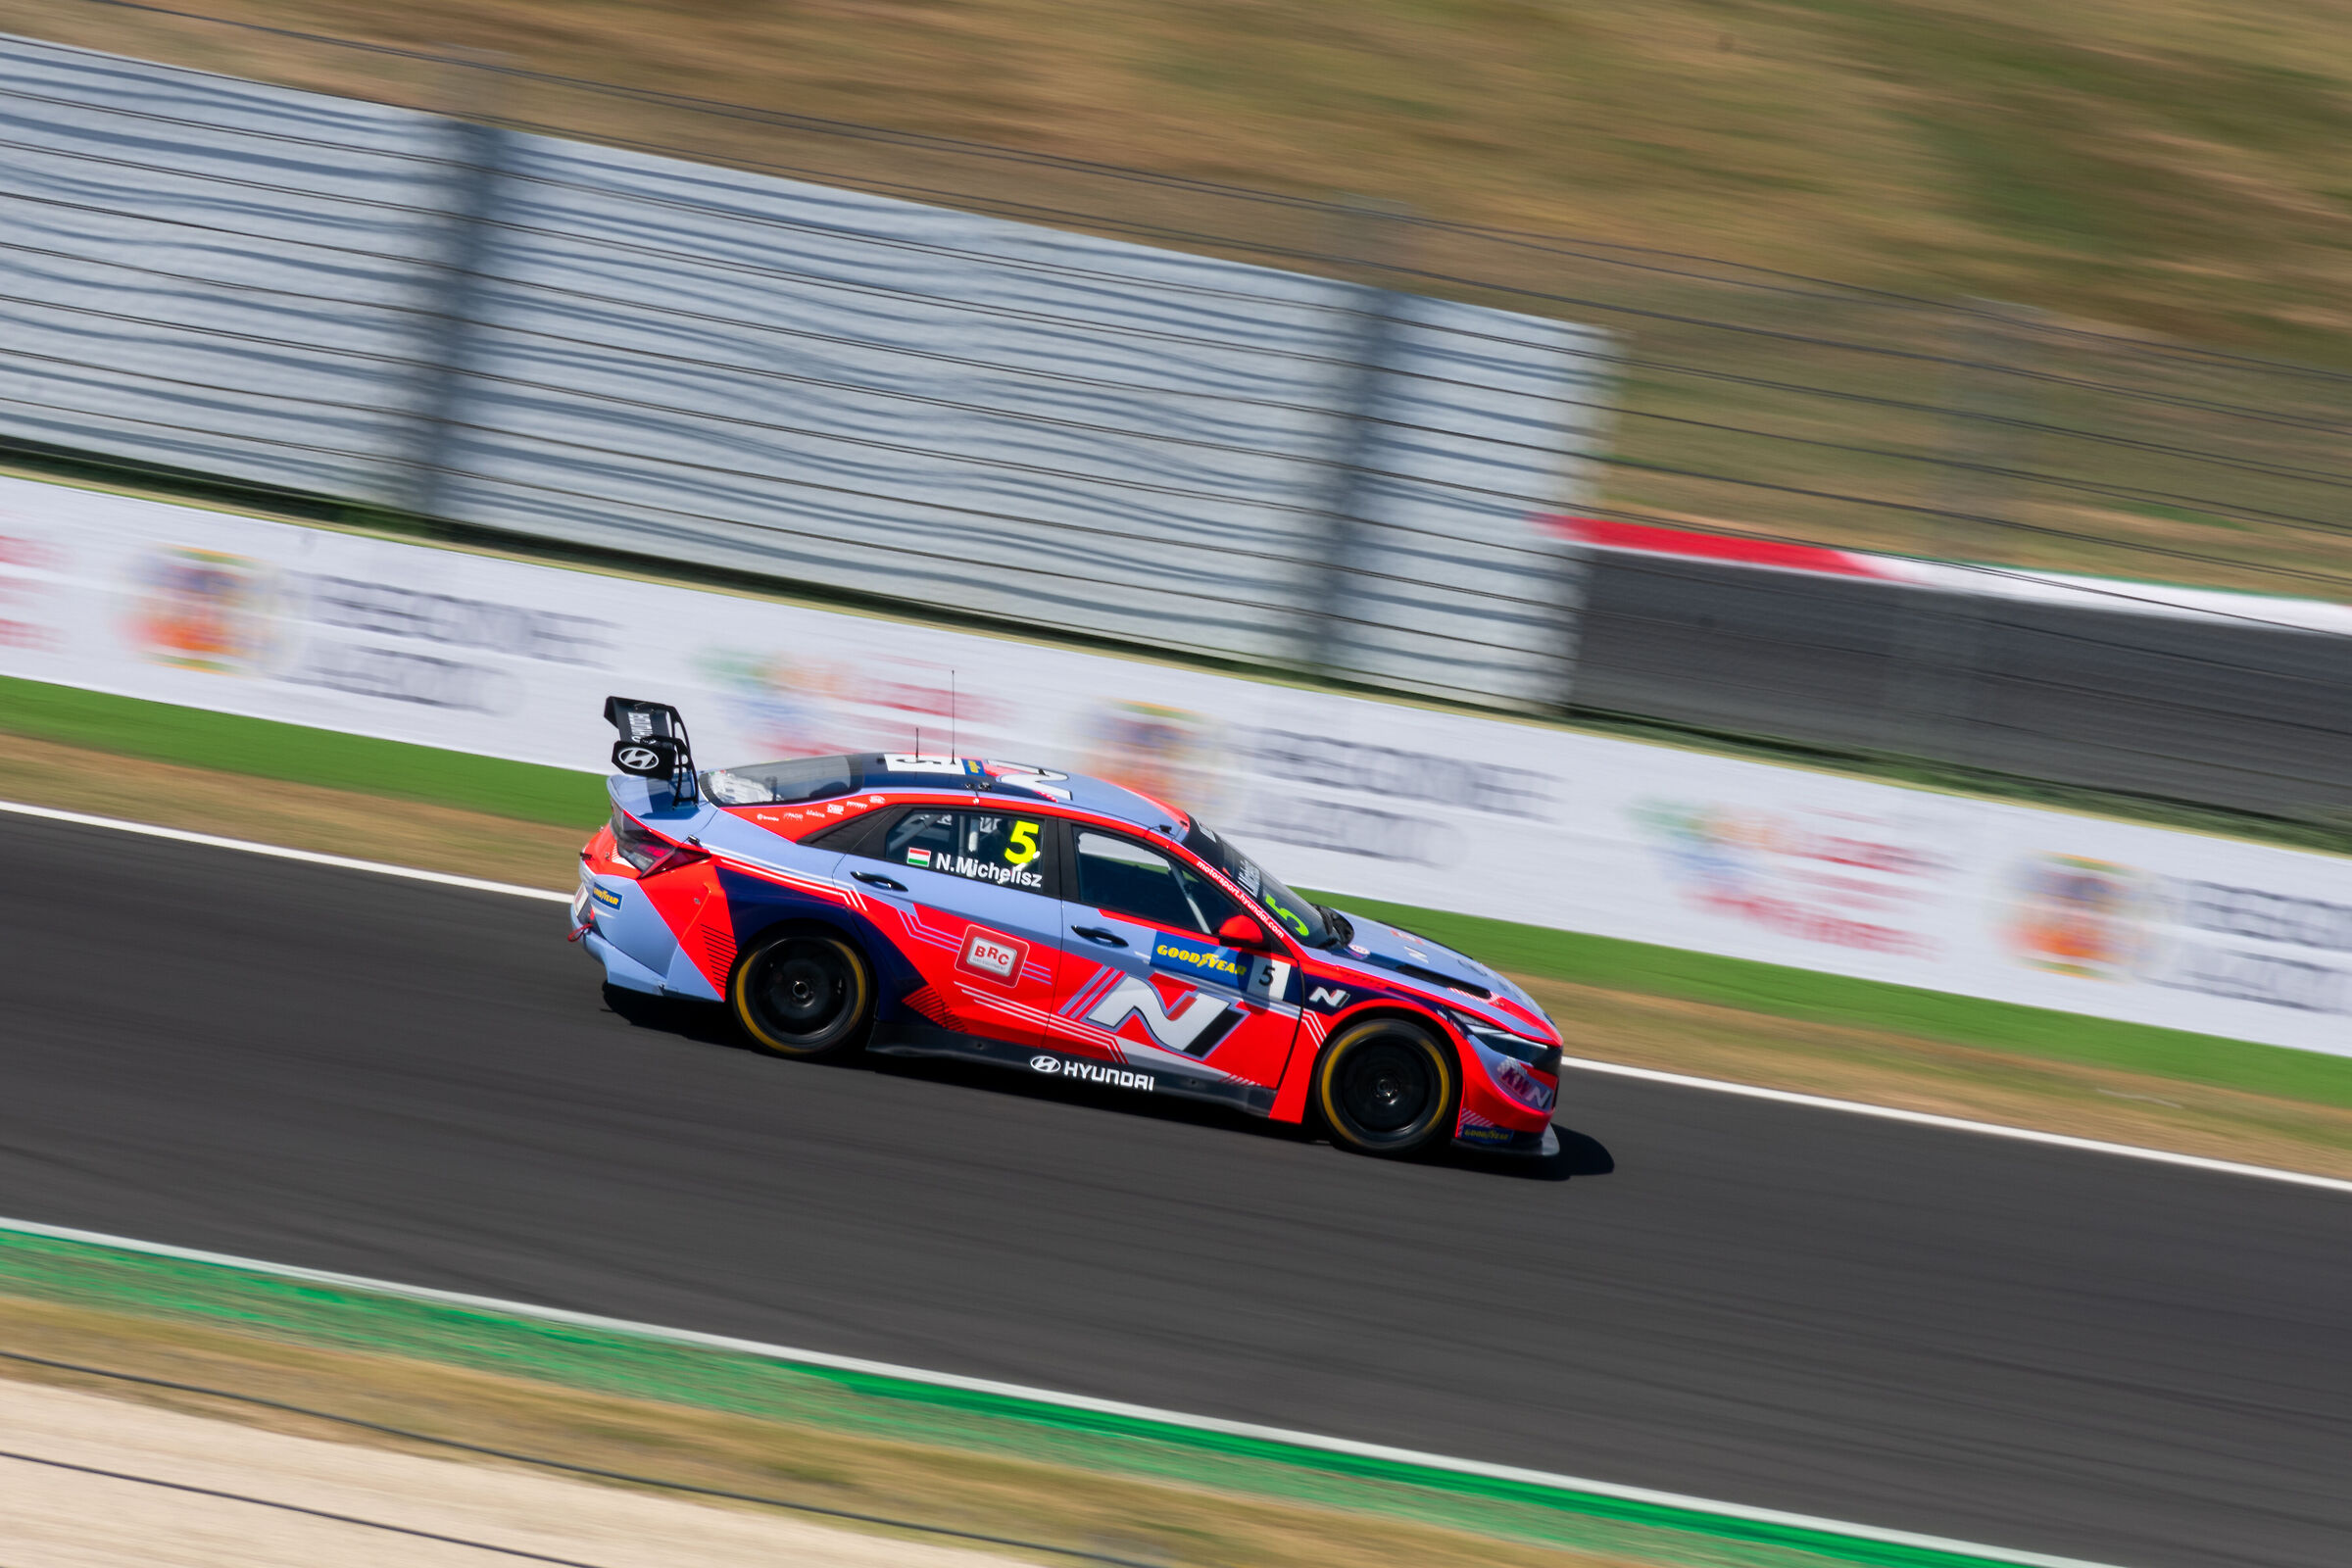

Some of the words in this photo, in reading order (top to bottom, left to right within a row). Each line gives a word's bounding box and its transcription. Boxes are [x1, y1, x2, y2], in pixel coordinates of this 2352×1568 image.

[1004, 820, 1040, 865] 5
[935, 853, 1043, 888] N.Michelisz
[1196, 860, 1285, 939] motorsport.hyundai.com
[1265, 894, 1309, 936] 5
[974, 945, 1010, 965] BRC
[1156, 945, 1248, 976] GOODYEAR
[1258, 965, 1276, 987] 5
[1063, 1060, 1154, 1092] HYUNDAI
